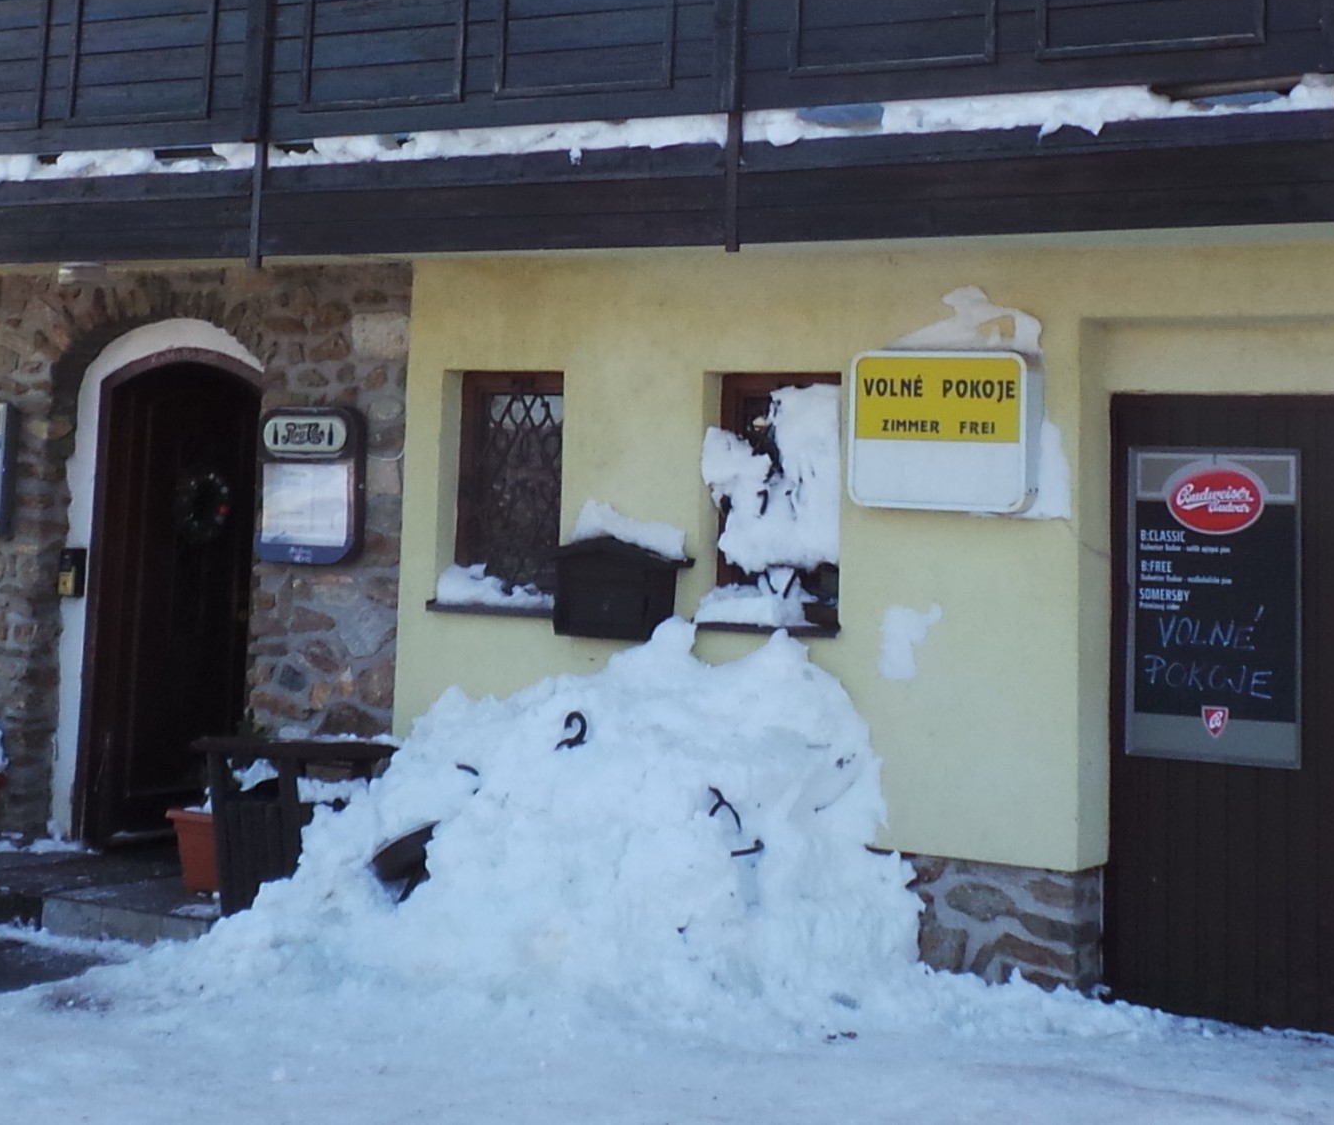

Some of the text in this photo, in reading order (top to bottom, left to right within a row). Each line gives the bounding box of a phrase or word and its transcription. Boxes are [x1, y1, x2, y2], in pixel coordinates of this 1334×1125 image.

[864, 374, 1015, 403] VOLNÉ POKOJE
[882, 419, 995, 434] ZIMMER FREI
[1176, 483, 1254, 510] Budweiser
[1140, 529, 1186, 543] B:CLASSIC
[1140, 560, 1173, 573] B:FREE
[1139, 588, 1190, 602] SOMERSBY
[1144, 654, 1273, 700] POKOJE
